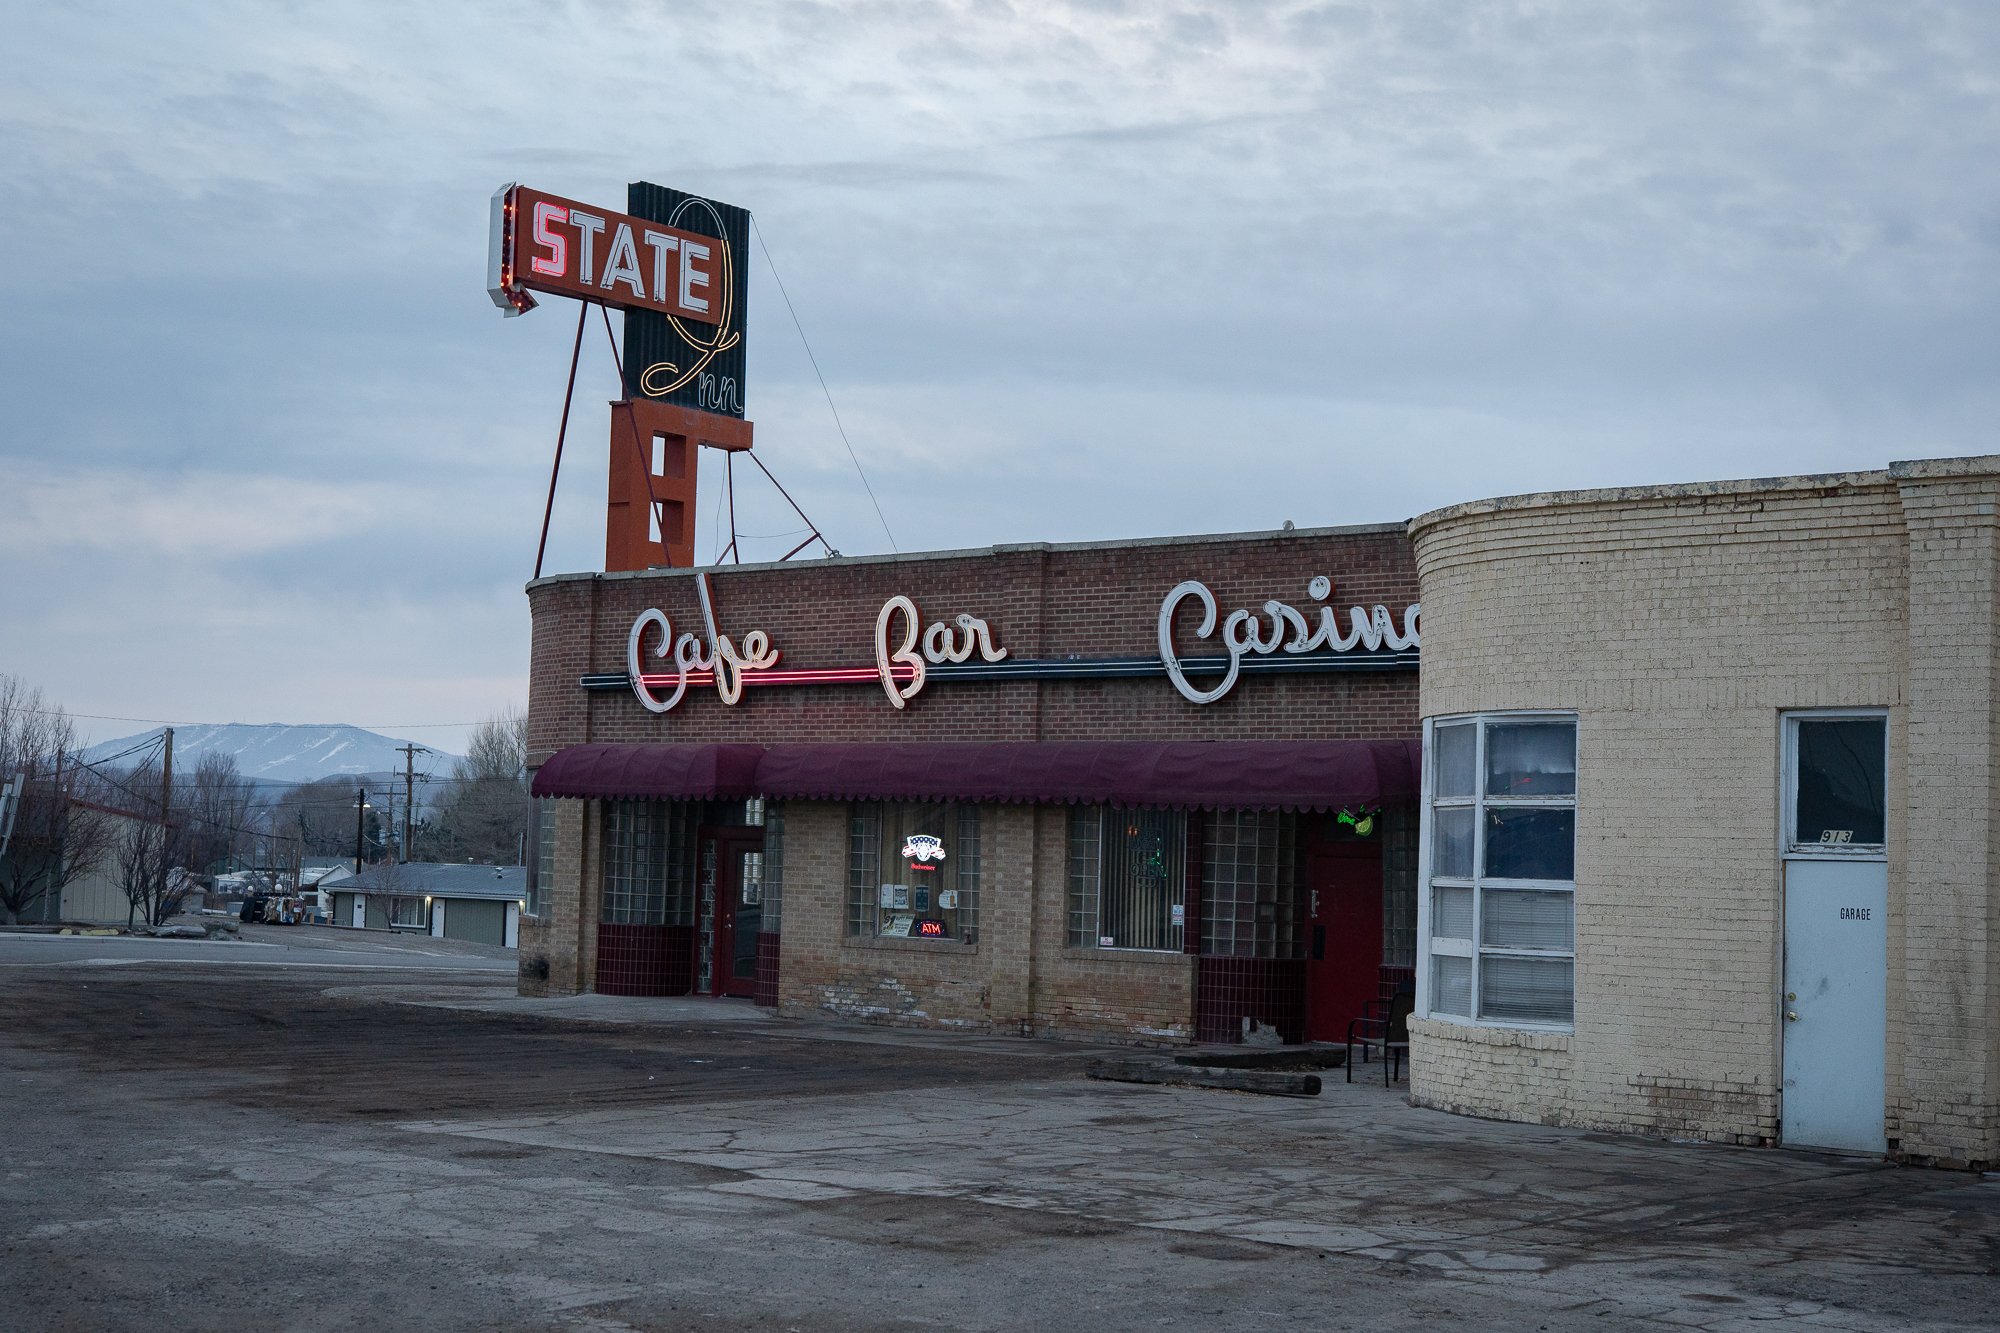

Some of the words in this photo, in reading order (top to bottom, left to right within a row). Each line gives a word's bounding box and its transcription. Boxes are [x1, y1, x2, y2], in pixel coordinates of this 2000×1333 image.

[531, 200, 710, 315] STATE
[627, 572, 783, 714] Cafe
[875, 595, 1009, 709] Bar
[1821, 830, 1851, 843] 913
[1840, 907, 1871, 921] GARAGE
[921, 923, 941, 936] ATM
